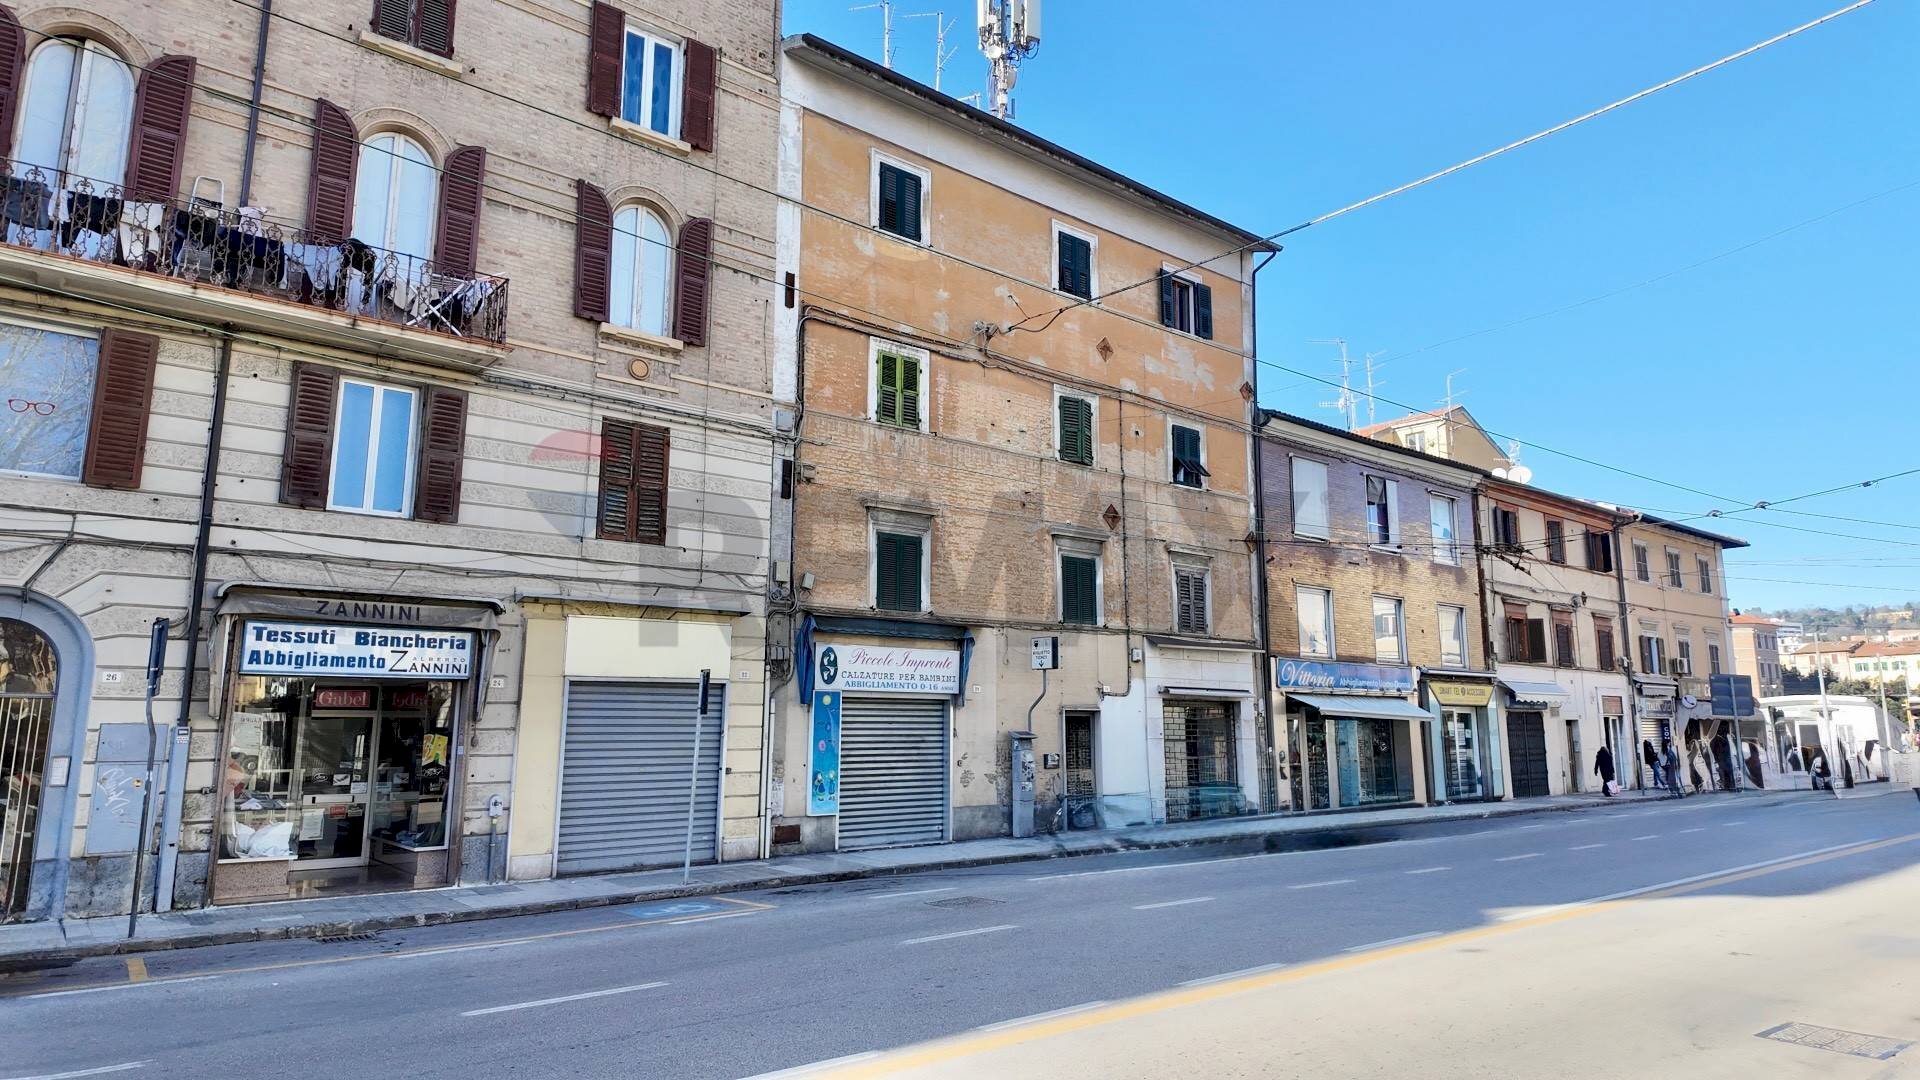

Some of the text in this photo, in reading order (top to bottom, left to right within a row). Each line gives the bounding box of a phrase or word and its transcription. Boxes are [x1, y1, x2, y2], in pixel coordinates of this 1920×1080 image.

[315, 600, 421, 622] ZANNINI
[252, 626, 467, 650] Tessuti Biancheria
[247, 649, 386, 670] Abbigliamento
[388, 650, 468, 674] ZANNINI
[849, 647, 953, 672] Piccole Impronte
[841, 671, 957, 683] CALZATURE PER BAMBINI
[1281, 661, 1335, 687] Vittoria
[844, 680, 918, 690] ABBIGLIAMENTO
[920, 683, 939, 691] 0-16
[319, 690, 368, 706] Gabel
